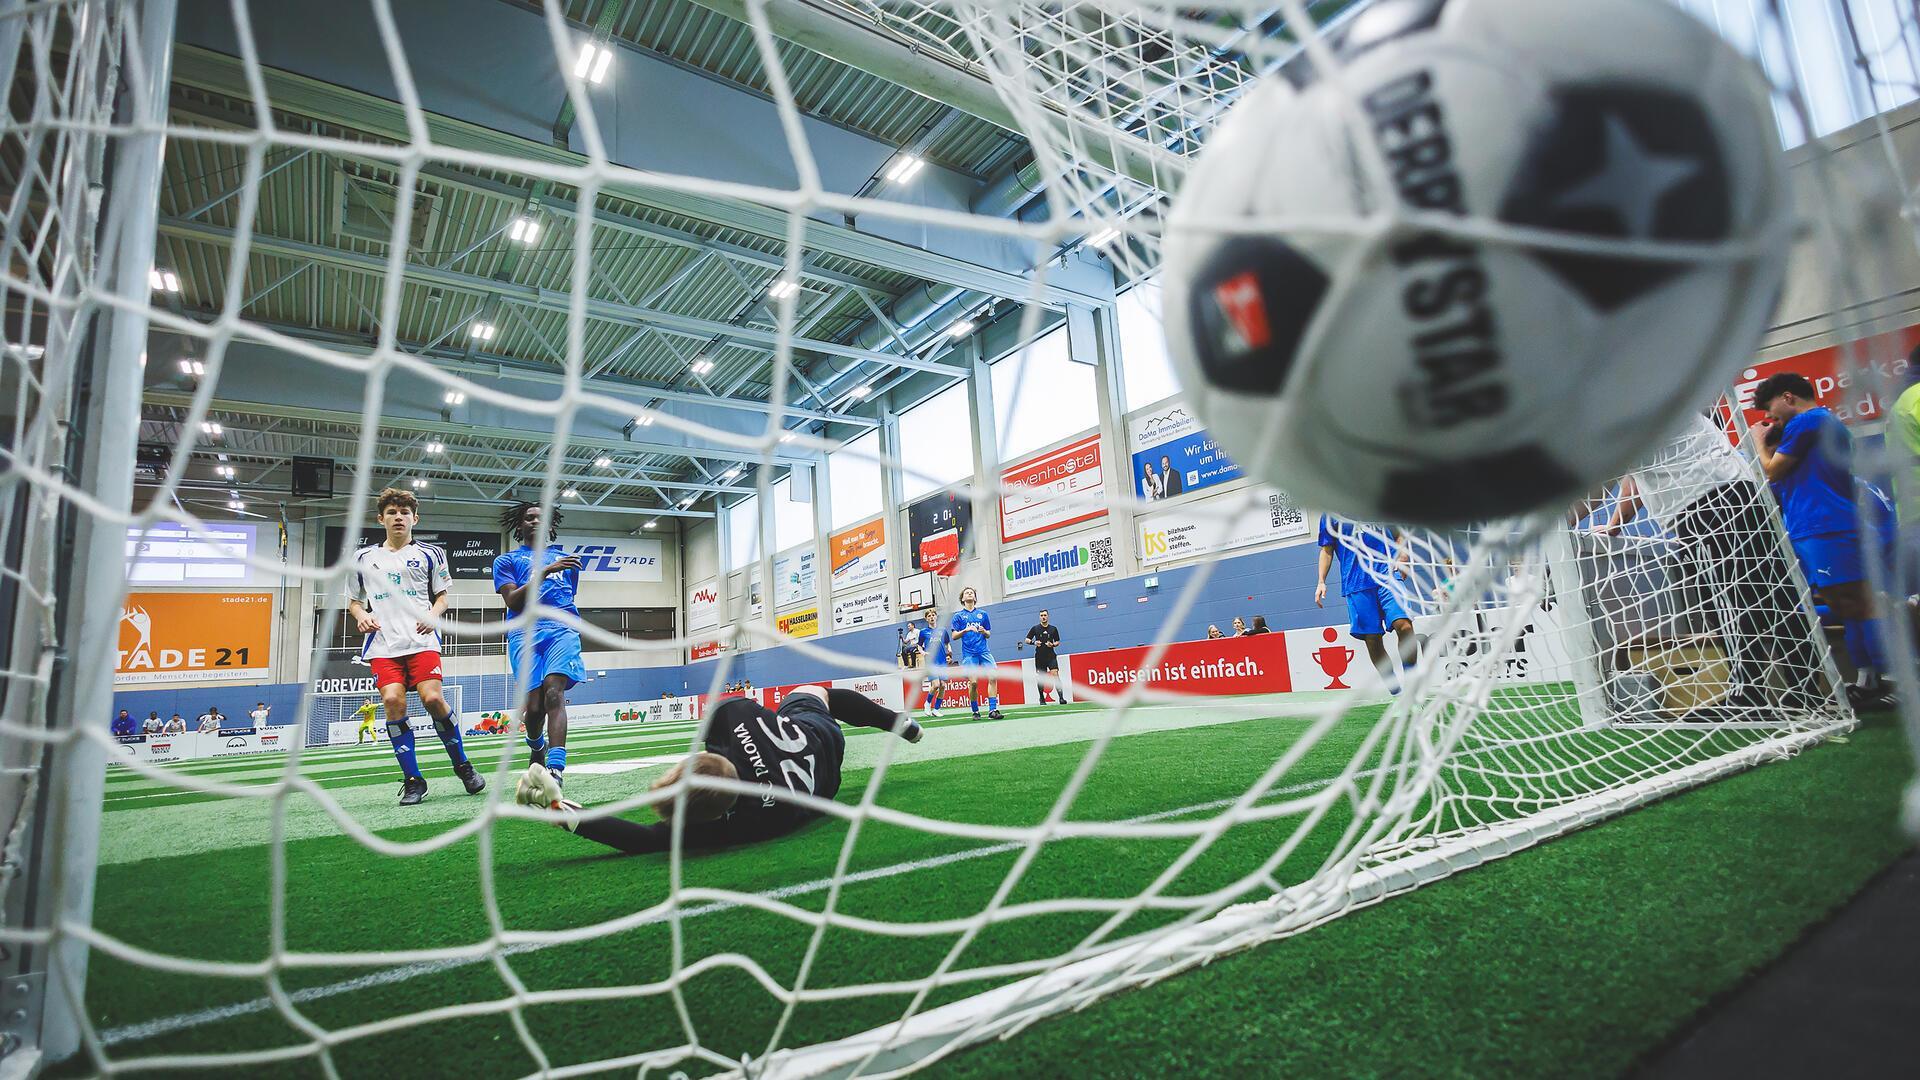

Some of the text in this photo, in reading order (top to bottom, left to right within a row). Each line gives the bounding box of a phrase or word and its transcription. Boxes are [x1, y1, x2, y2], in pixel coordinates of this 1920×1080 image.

[1138, 430, 1157, 441] DaMa
[1184, 444, 1200, 457] Wir
[1199, 456, 1213, 466] um
[1004, 448, 1098, 490] havenhostel
[1201, 463, 1241, 479] www.dama-
[466, 540, 481, 548] EIN
[1168, 534, 1187, 542] rohde.
[1169, 540, 1192, 551] steffen.
[452, 549, 496, 557] HANDWERK.
[614, 556, 656, 566] STADE
[1013, 545, 1079, 580] Buhrfeind
[221, 596, 268, 604] stade21.de
[842, 600, 854, 609] Hans
[854, 596, 868, 607] Nagel
[868, 593, 883, 603] GmbH
[114, 648, 250, 670] TADE 21
[1088, 656, 1264, 685] Dabeisein ist einfach.
[854, 681, 878, 693] Herzlich
[669, 699, 683, 713] mohr
[733, 722, 769, 778] PALOMA
[756, 715, 816, 799] 26
